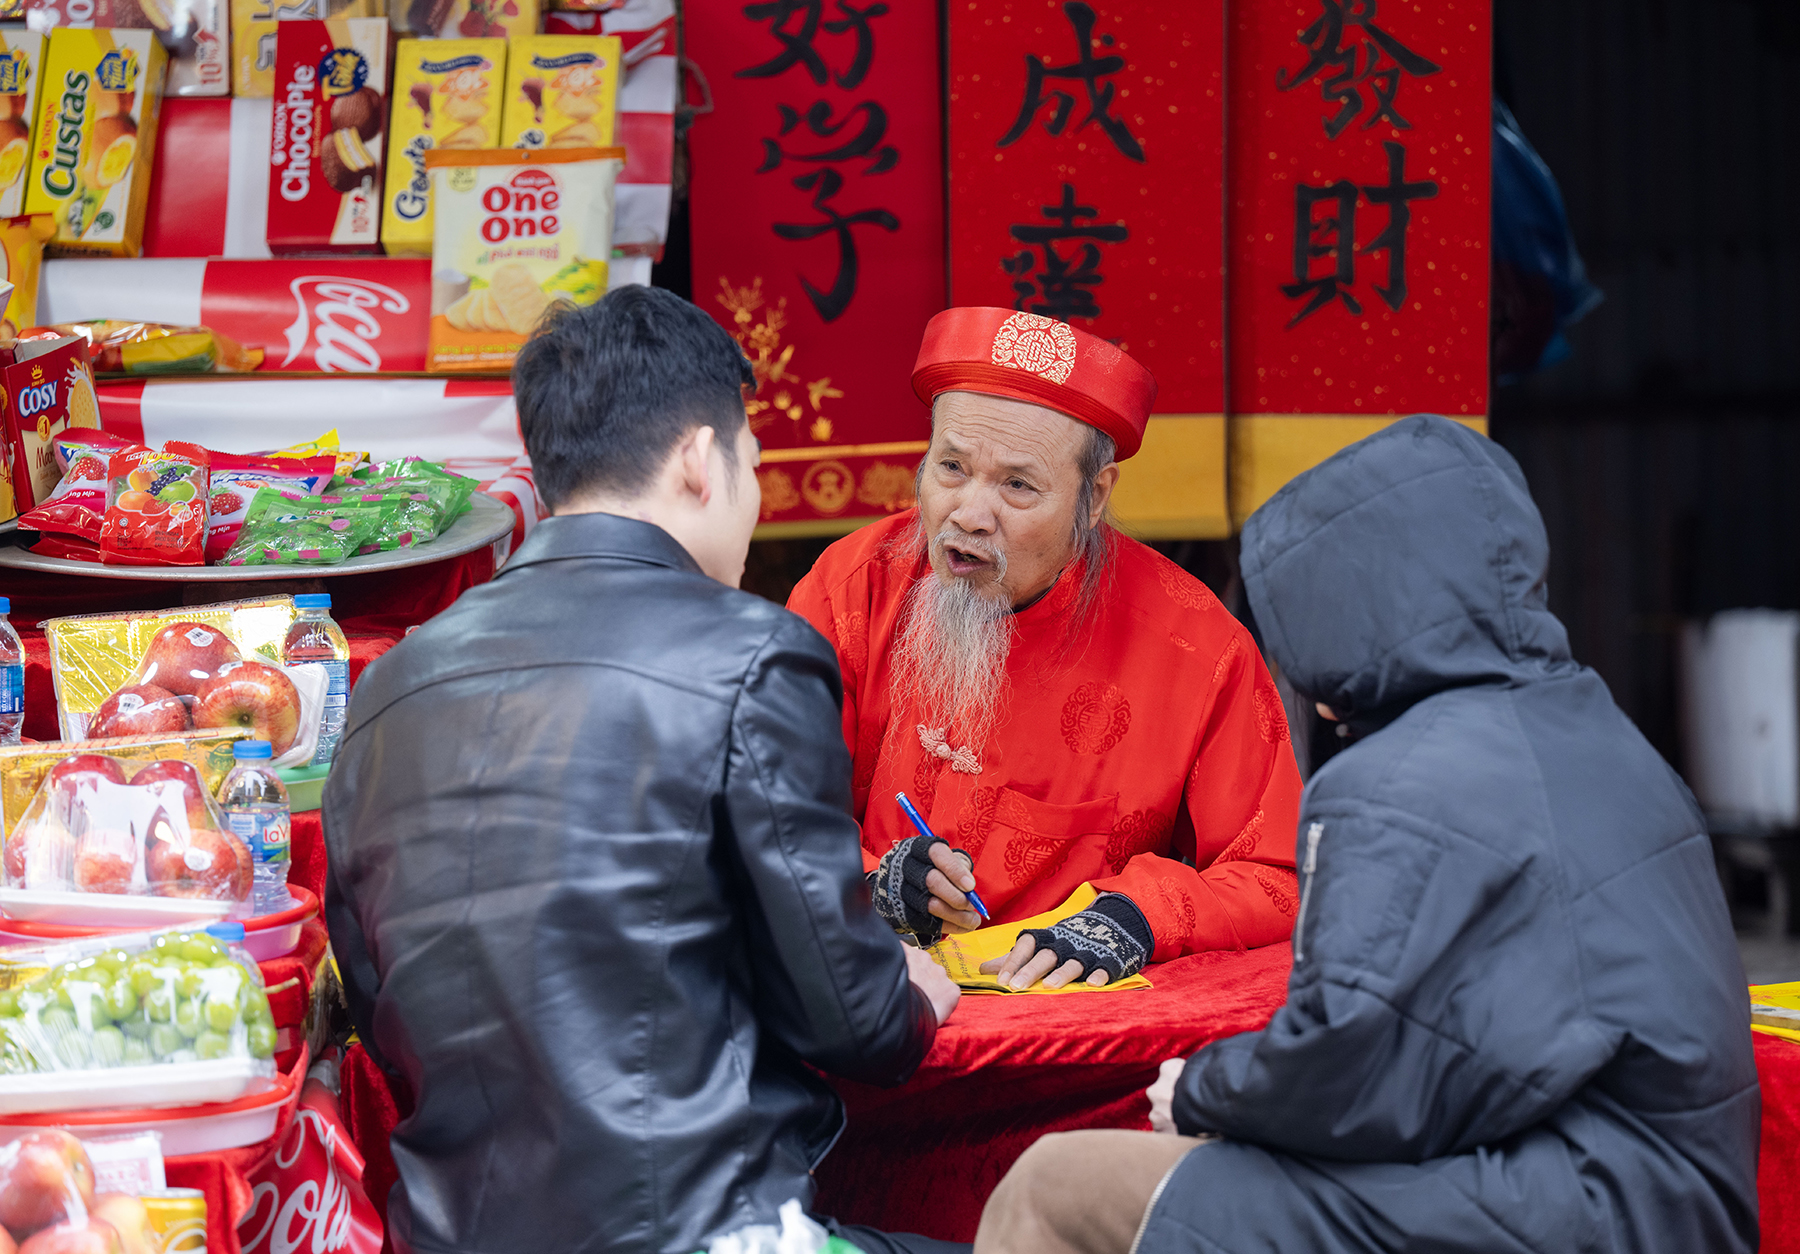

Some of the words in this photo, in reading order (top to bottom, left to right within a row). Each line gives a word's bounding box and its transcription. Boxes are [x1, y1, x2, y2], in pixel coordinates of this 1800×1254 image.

[43, 70, 90, 198] Custas
[272, 102, 288, 151] ORION
[280, 64, 316, 201] ChocoPie
[482, 186, 559, 213] One
[481, 215, 560, 243] One
[18, 379, 59, 418] COSY
[264, 821, 289, 844] laV
